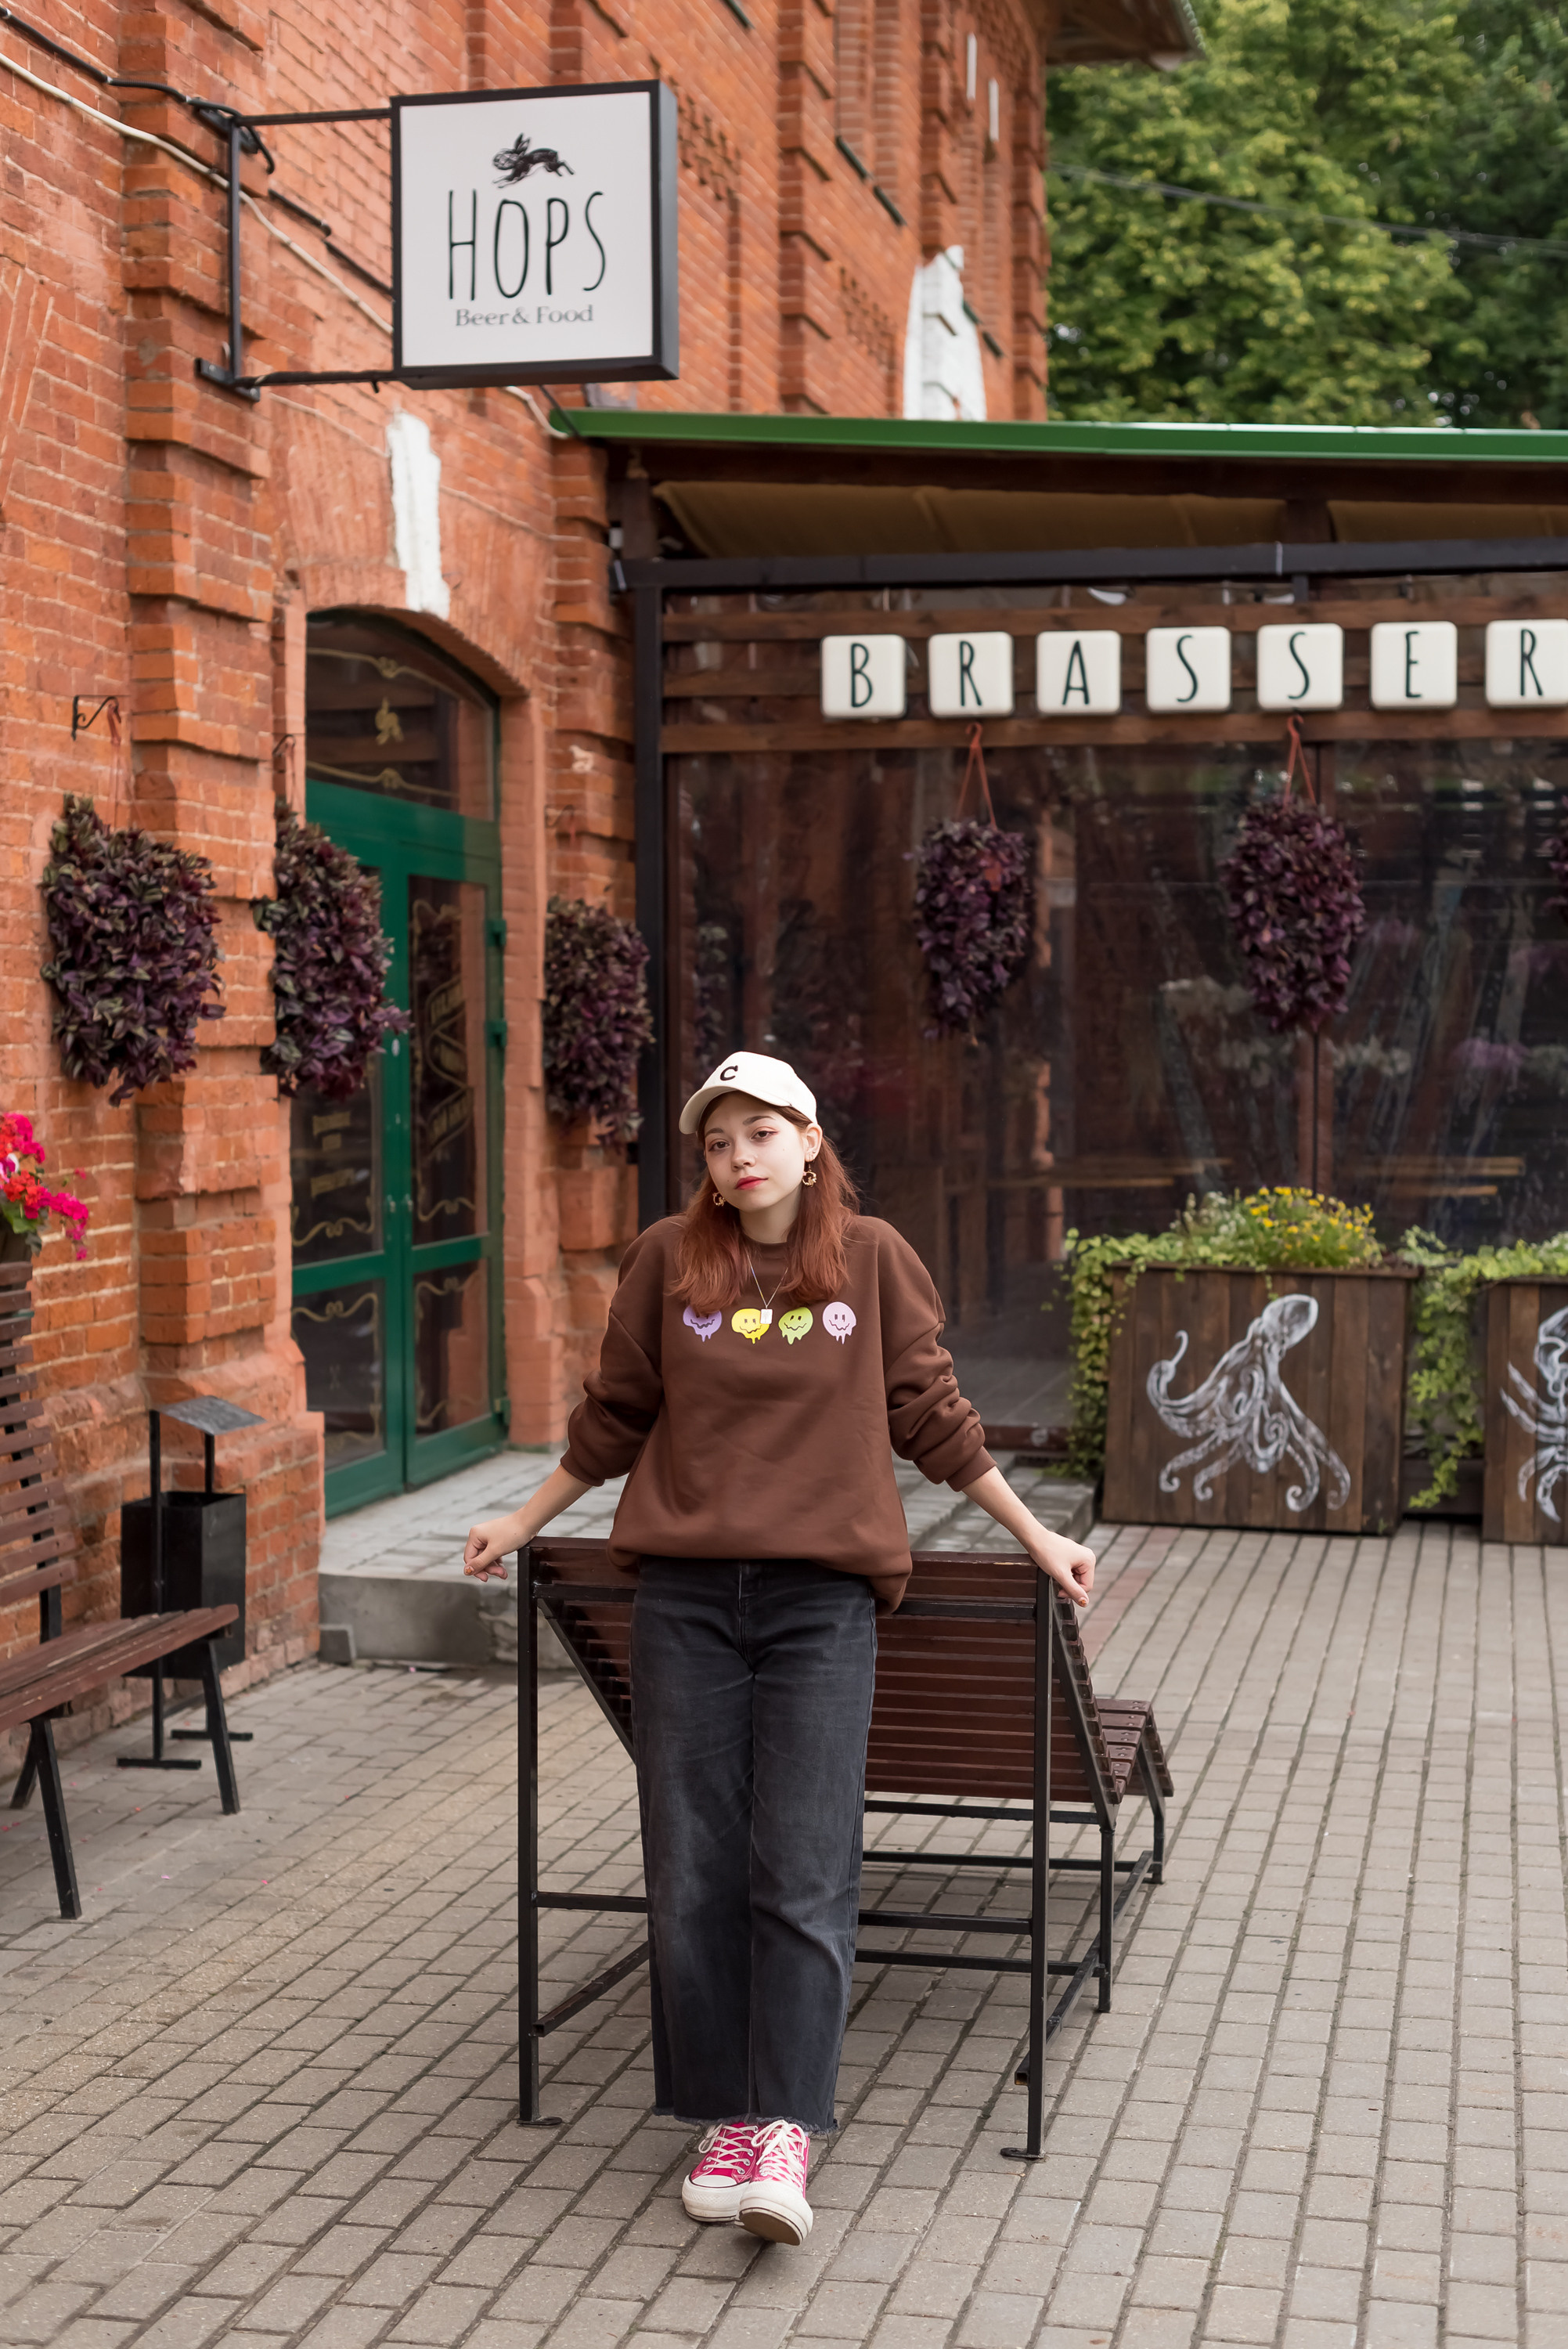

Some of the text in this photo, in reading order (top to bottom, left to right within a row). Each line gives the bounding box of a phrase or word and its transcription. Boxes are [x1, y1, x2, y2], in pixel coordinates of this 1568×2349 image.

[449, 189, 606, 301] HOPS
[455, 308, 509, 327] Beer
[535, 305, 593, 324] Food
[849, 629, 1544, 708] BRASSER
[719, 1065, 738, 1081] C
